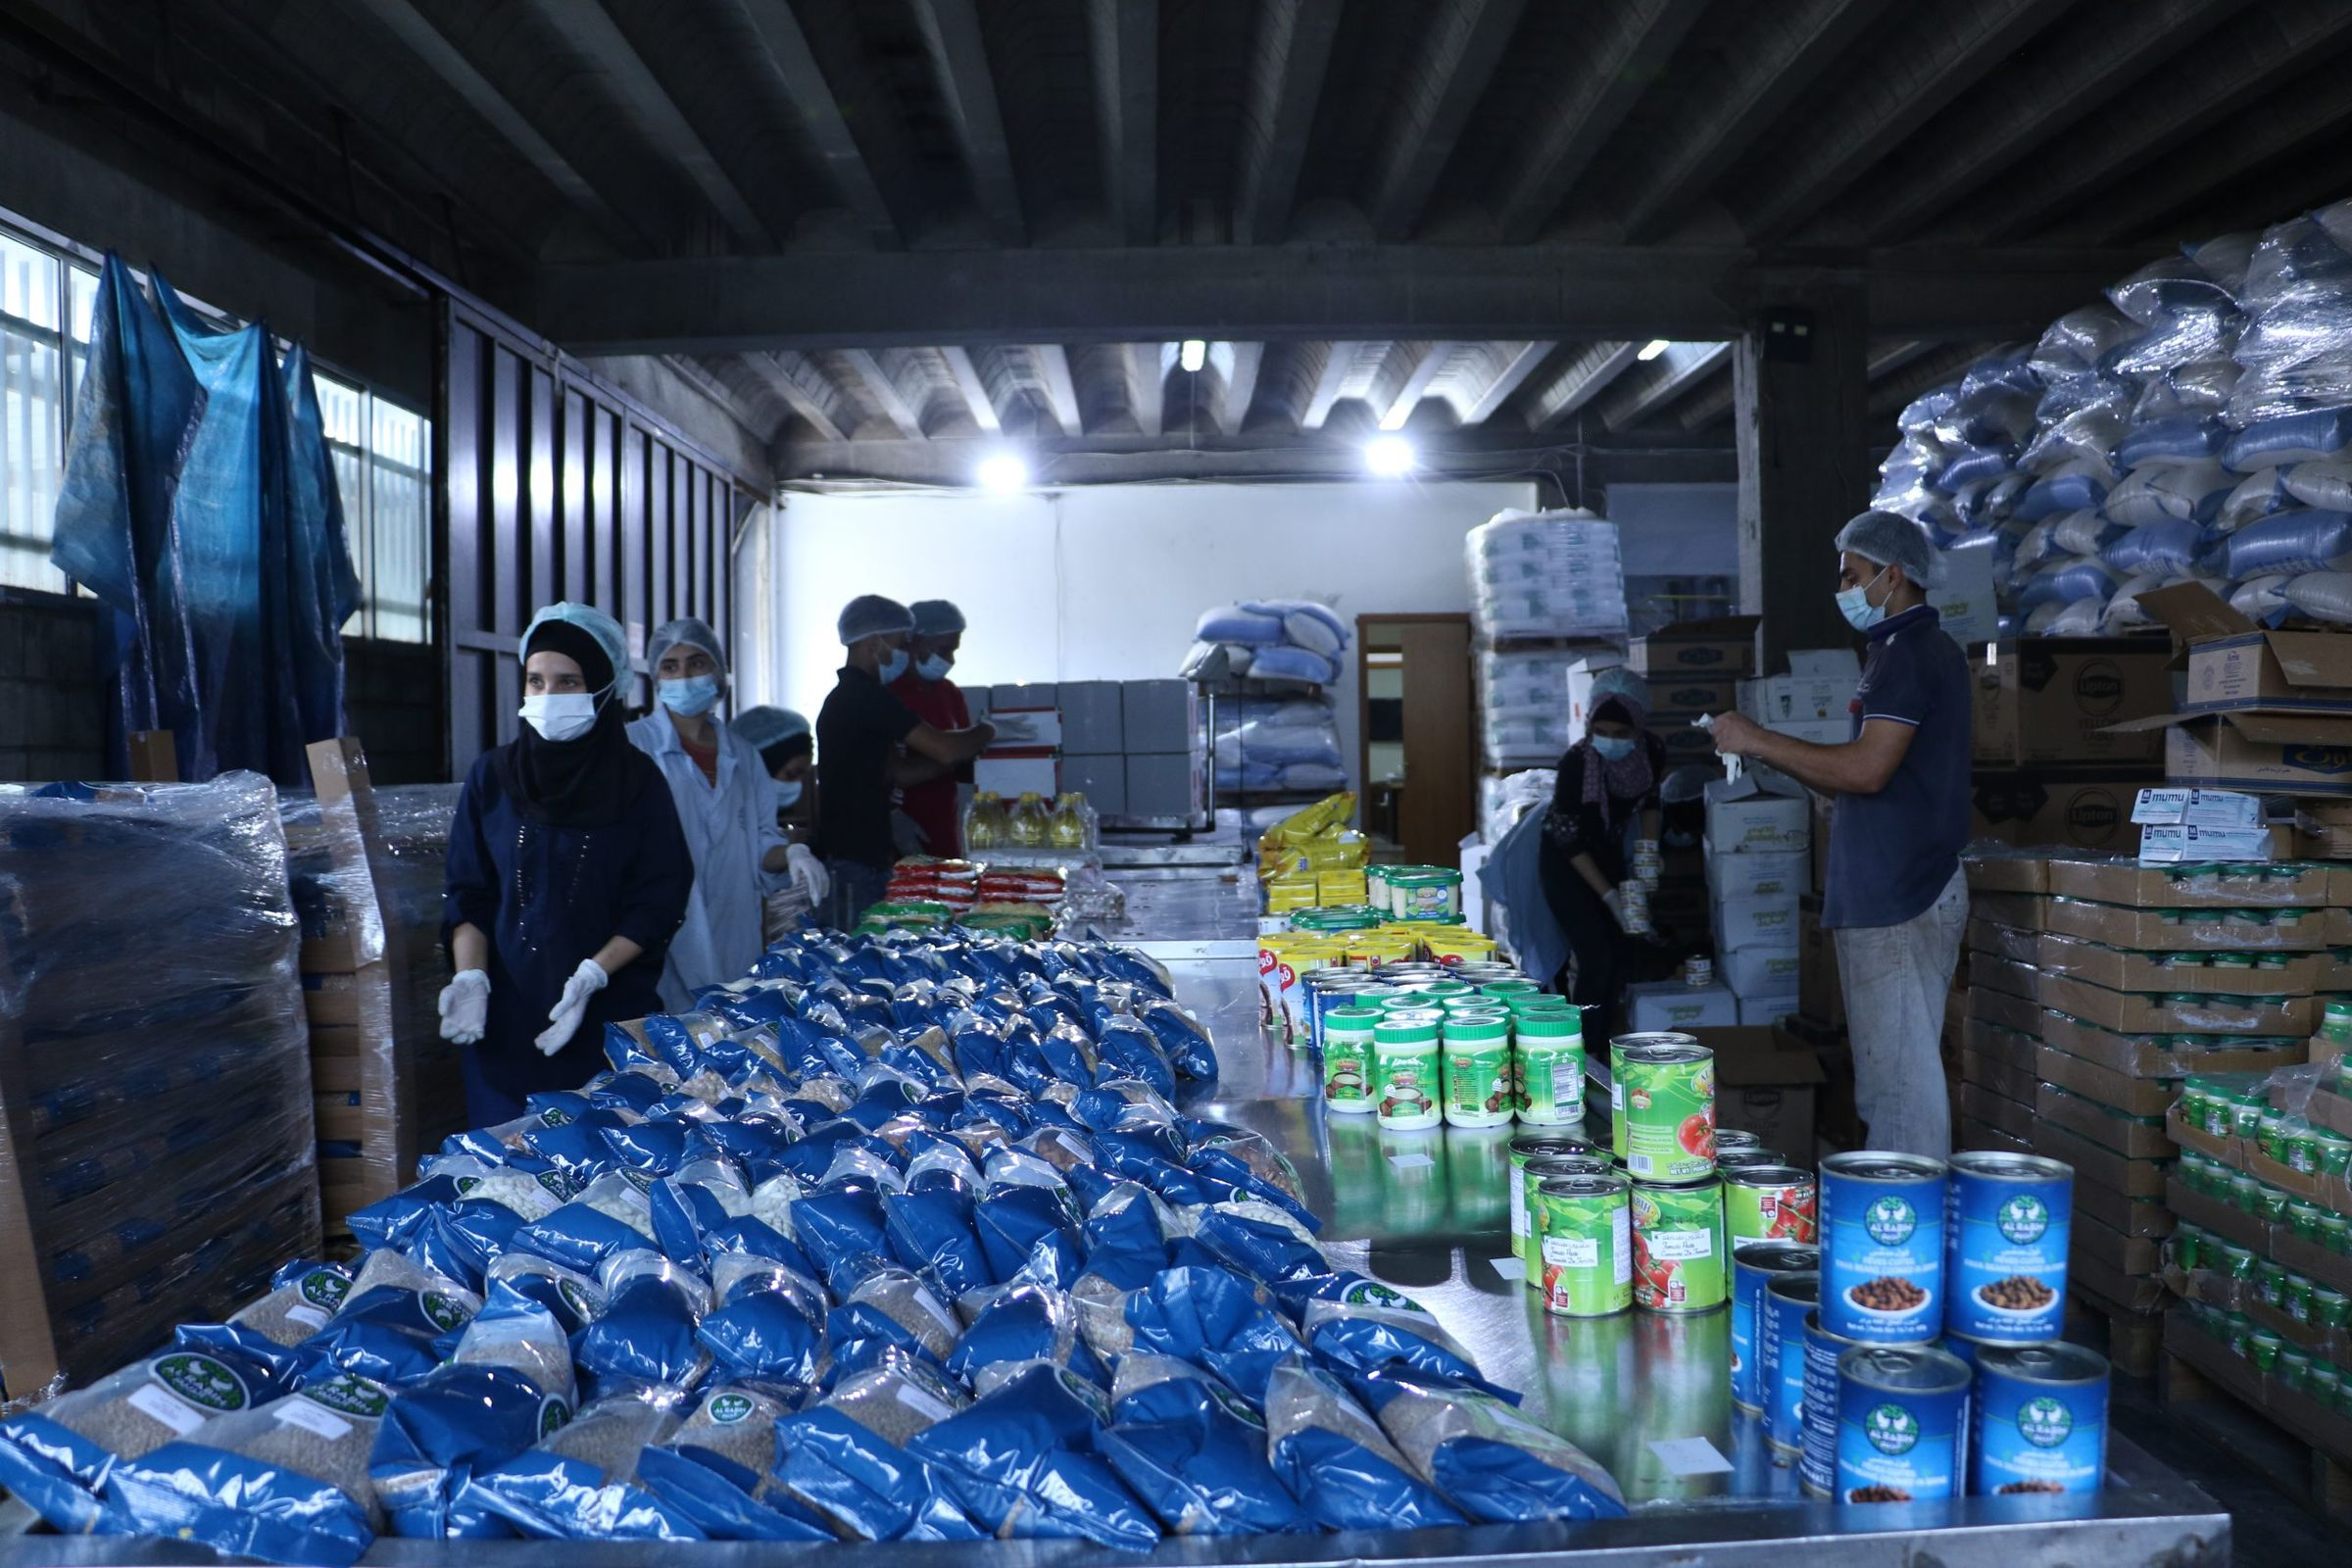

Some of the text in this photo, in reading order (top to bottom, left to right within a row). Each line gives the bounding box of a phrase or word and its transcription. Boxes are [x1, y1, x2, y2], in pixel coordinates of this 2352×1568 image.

[2079, 677, 2118, 695] Lipton
[2152, 793, 2184, 802] mumu
[2201, 793, 2224, 802] mumu
[2071, 808, 2113, 823] Lipton
[2154, 829, 2181, 838] mumu
[2199, 829, 2227, 838] mumu
